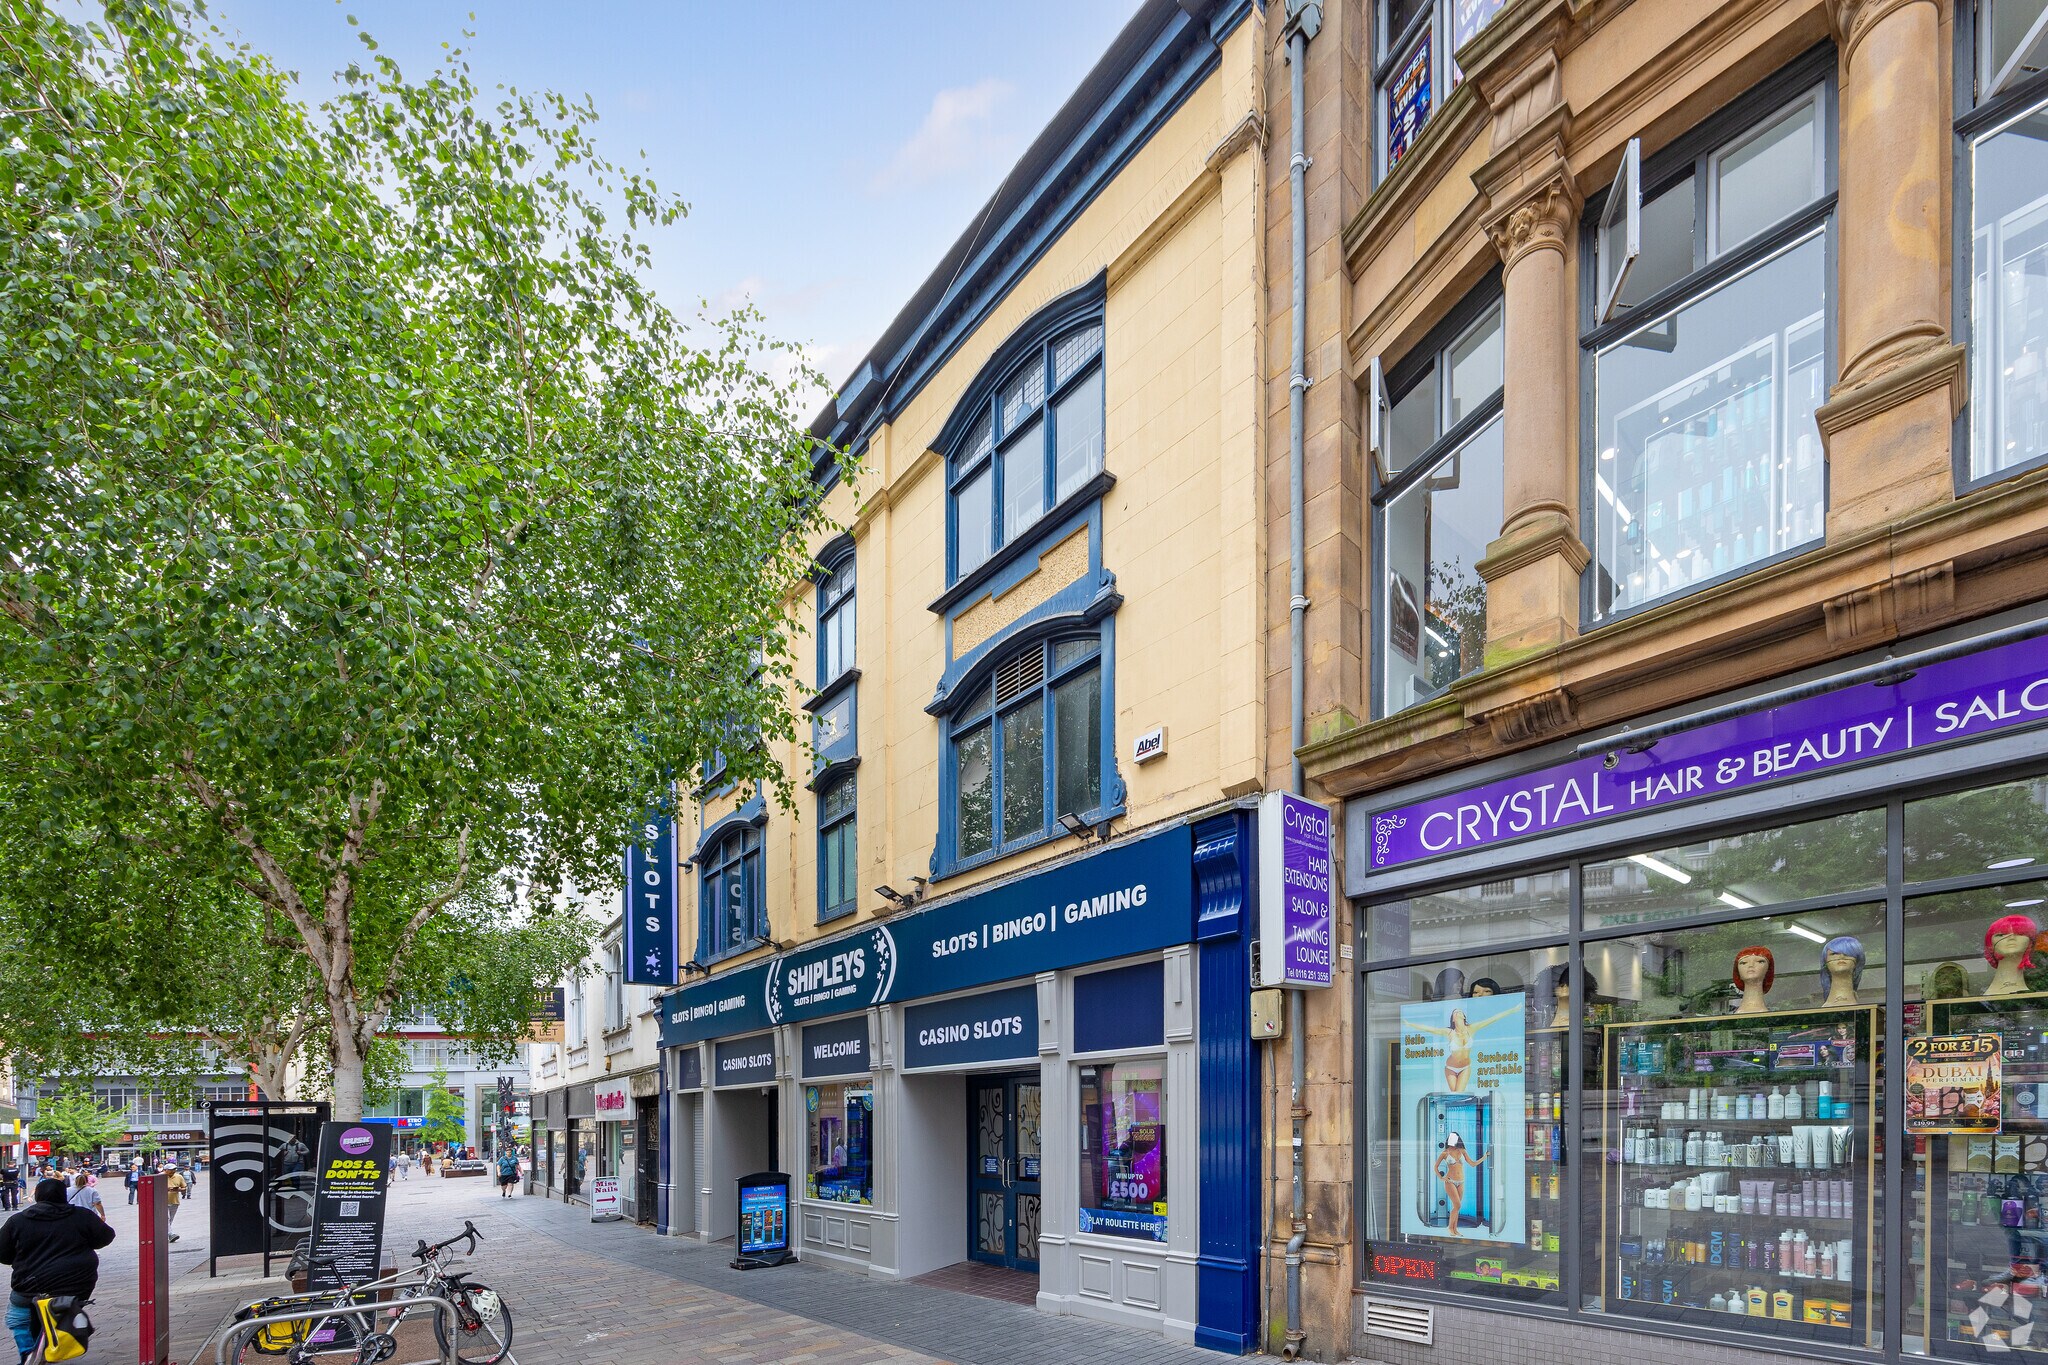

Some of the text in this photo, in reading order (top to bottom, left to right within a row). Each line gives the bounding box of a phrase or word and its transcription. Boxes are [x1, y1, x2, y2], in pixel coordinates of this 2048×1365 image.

[1393, 44, 1427, 99] SUPER
[1137, 733, 1161, 753] Abel
[1420, 773, 1613, 852] CRYSTAL
[1629, 766, 1704, 804] HAIR
[1716, 758, 1745, 785] &
[1752, 717, 1893, 777] BEAUTY
[1285, 804, 1327, 837] Crystal
[1308, 856, 1328, 874] HAIR
[644, 824, 661, 932] SLOTS
[1285, 867, 1327, 892] EXTENSIONS
[1292, 897, 1328, 918] SALON &
[932, 931, 977, 958] SLOTS
[992, 912, 1046, 944] BINGO
[1064, 884, 1147, 924] GAMING
[1293, 926, 1328, 946] TANNING
[1297, 946, 1328, 965] LOUNGE
[787, 948, 865, 996] SHIPLEYS
[1287, 968, 1295, 977] Tel
[1295, 969, 1306, 979] 0116
[1308, 970, 1316, 979] 251
[794, 996, 809, 1007] SLOTS
[813, 990, 830, 1003] BINGO
[834, 984, 857, 998] GAMING
[672, 1010, 689, 1024] SLOTS
[694, 1004, 713, 1019] BINGO
[718, 995, 746, 1012] GAMING
[919, 1015, 1023, 1046] CASINO SLOTS
[1405, 1034, 1426, 1046] Hello
[814, 1040, 860, 1059] WELCOME
[1404, 1048, 1445, 1060] Sunshine
[1477, 1051, 1519, 1064] Sunbeds
[1914, 1041, 1928, 1057] 2
[1930, 1041, 1958, 1053] FOR
[1960, 1039, 1993, 1053] £15
[722, 1053, 772, 1071] CASINO SLOTS
[1477, 1064, 1522, 1078] available
[1923, 1066, 1983, 1078] DUBAI
[1477, 1077, 1500, 1089] here
[332, 1160, 376, 1169] DOS &
[325, 1170, 381, 1179] DON'TS
[1110, 1180, 1149, 1199] £500
[1088, 1216, 1160, 1232] PLAY ROULETTE HERE
[1710, 1231, 1722, 1265] DCM
[1375, 1254, 1435, 1279] OPEN
